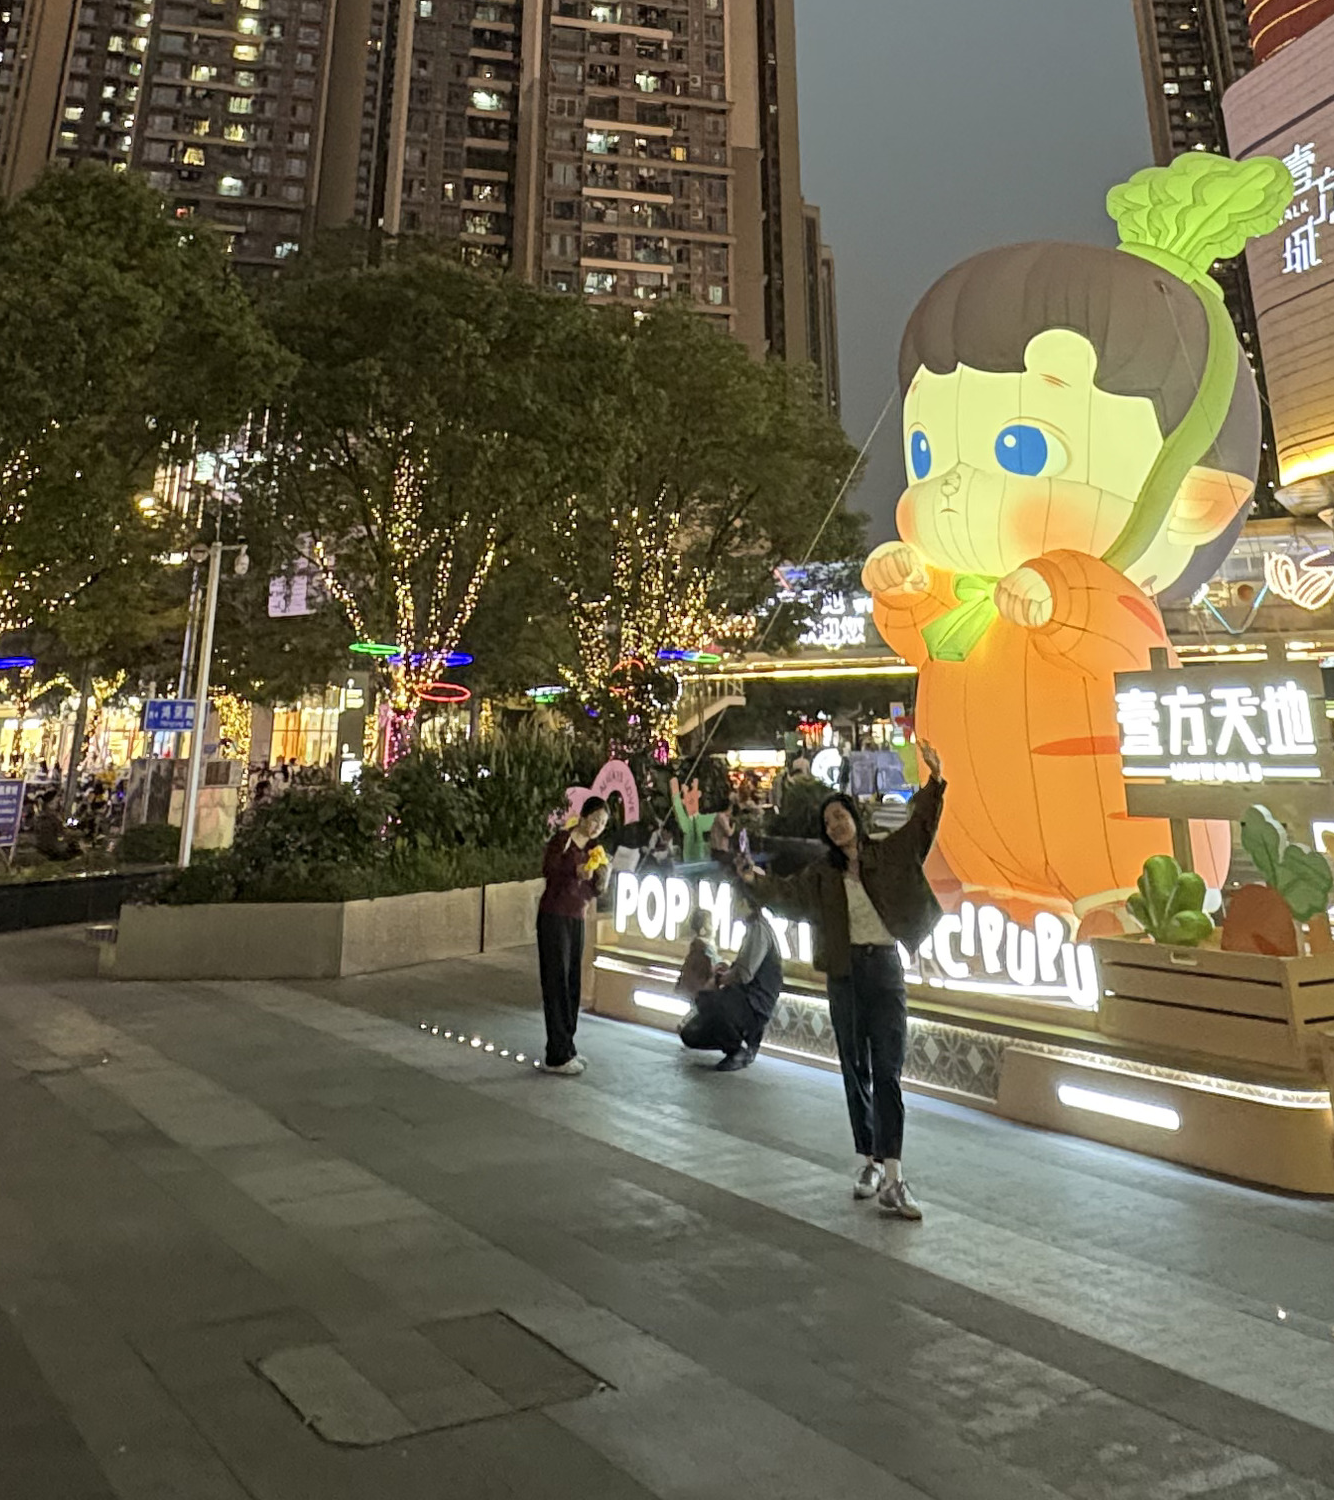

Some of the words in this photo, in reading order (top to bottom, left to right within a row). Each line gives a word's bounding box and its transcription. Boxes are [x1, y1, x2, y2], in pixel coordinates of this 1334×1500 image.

[1115, 680, 1318, 756] 壹方天地
[615, 871, 690, 942] POP
